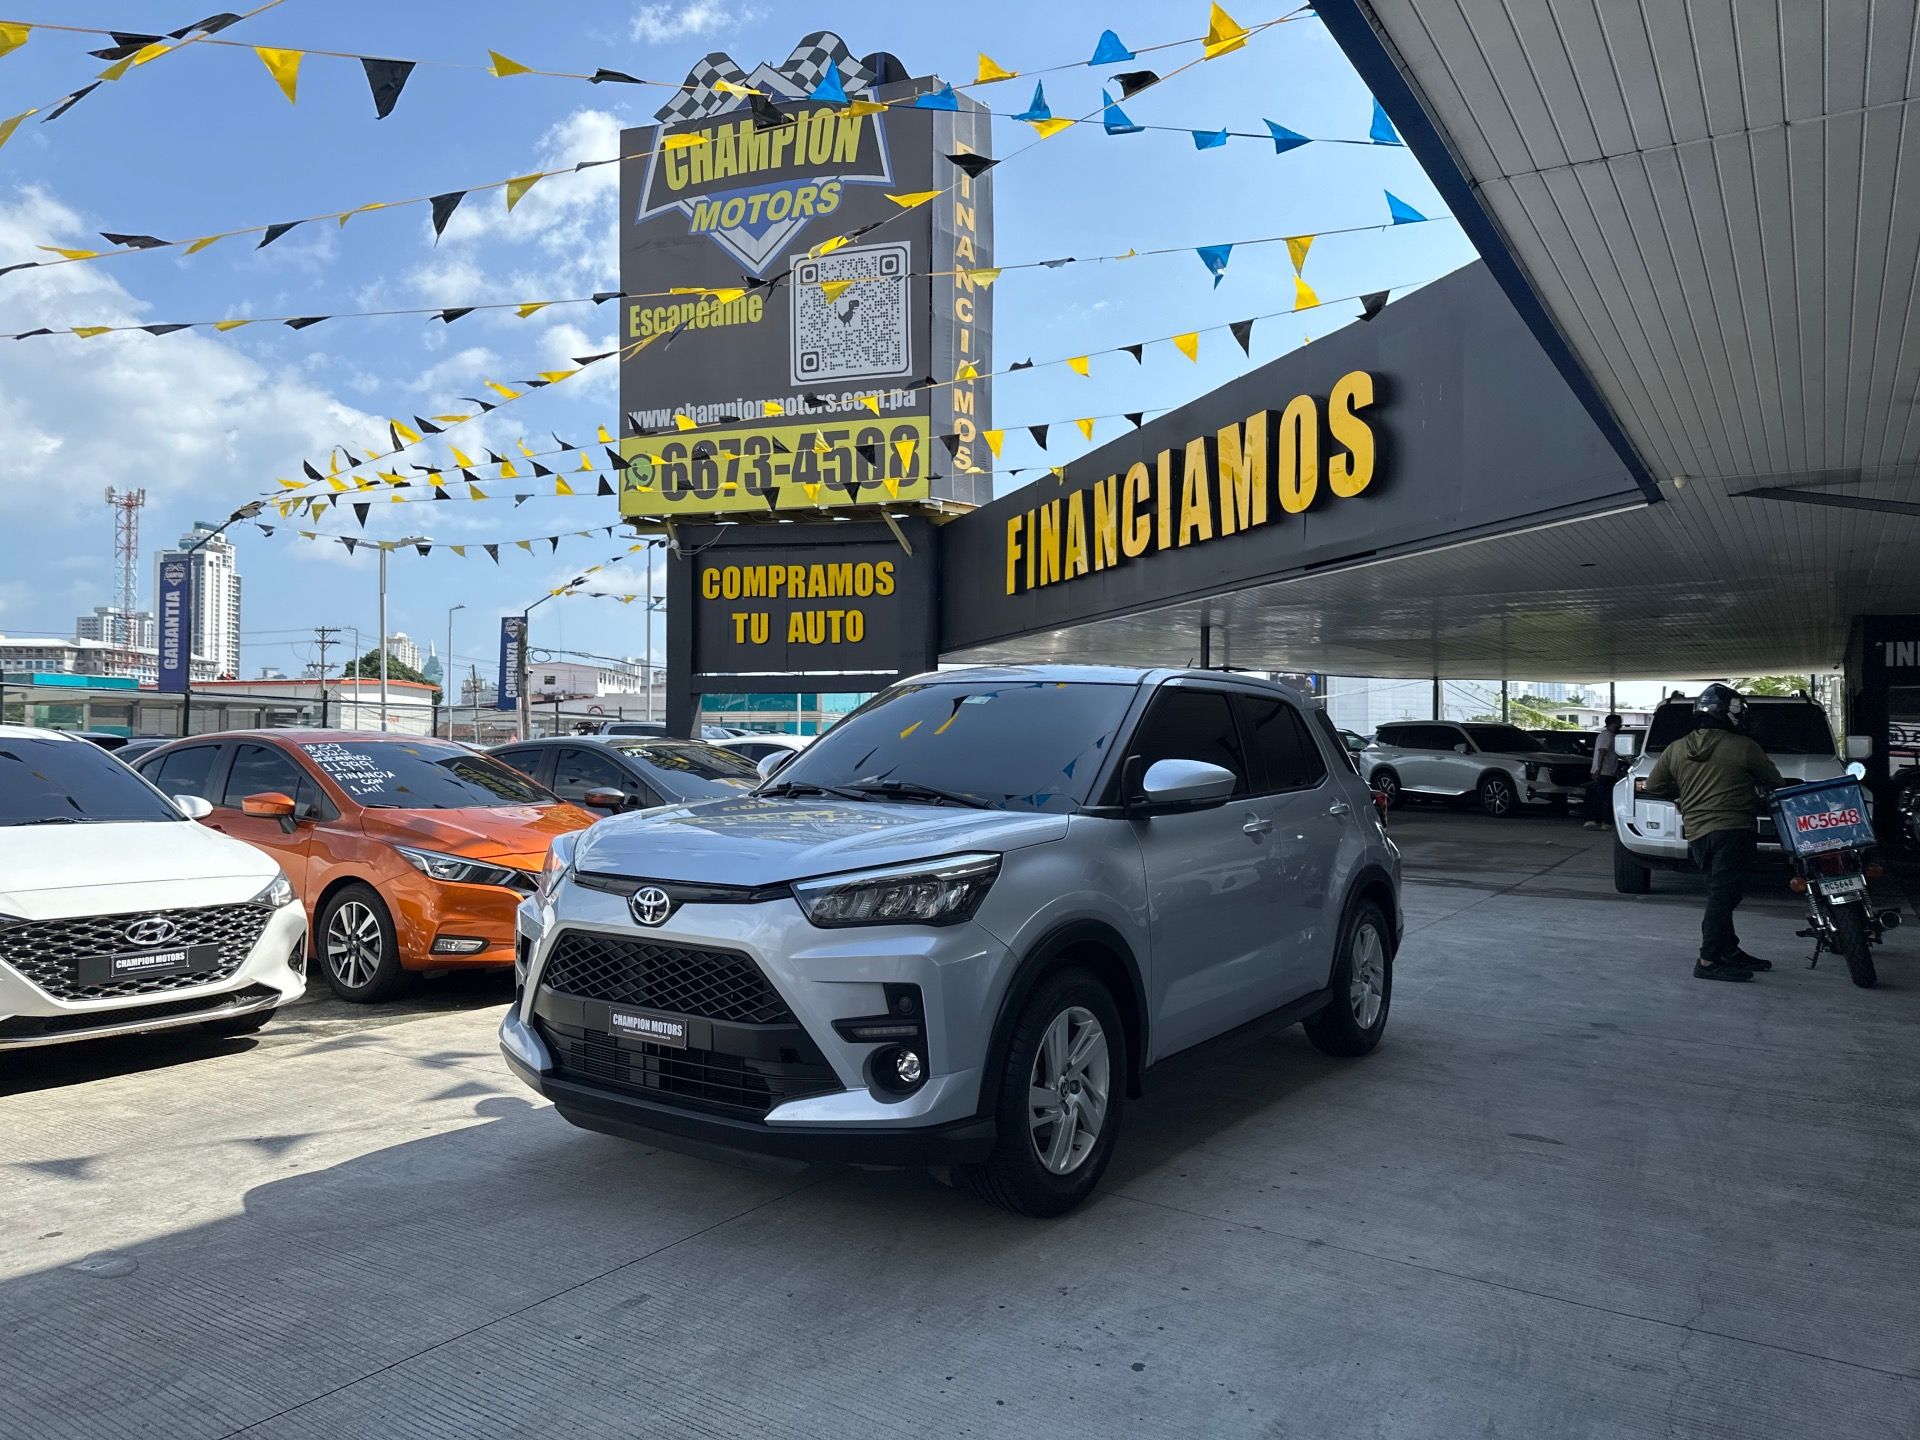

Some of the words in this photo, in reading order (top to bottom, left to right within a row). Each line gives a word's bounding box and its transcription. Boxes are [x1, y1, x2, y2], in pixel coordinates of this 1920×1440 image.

[665, 107, 863, 191] CHAMPION
[691, 182, 841, 232] MOTORS
[661, 425, 920, 501] 6673-4508
[1006, 370, 1374, 595] FINANCIAMOS
[702, 561, 895, 600] COMPRAMOS
[164, 590, 180, 670] GARANTIA
[732, 612, 769, 644] TU
[788, 609, 865, 645] AUTO
[505, 641, 519, 698] CONFIANZA
[1885, 641, 1920, 667] IN
[1797, 809, 1860, 832] MC5648
[116, 956, 155, 969] CHAMPION
[156, 952, 185, 964] MOTORS
[612, 1013, 651, 1031] CHAMPION
[651, 1020, 683, 1037] MOTORS
